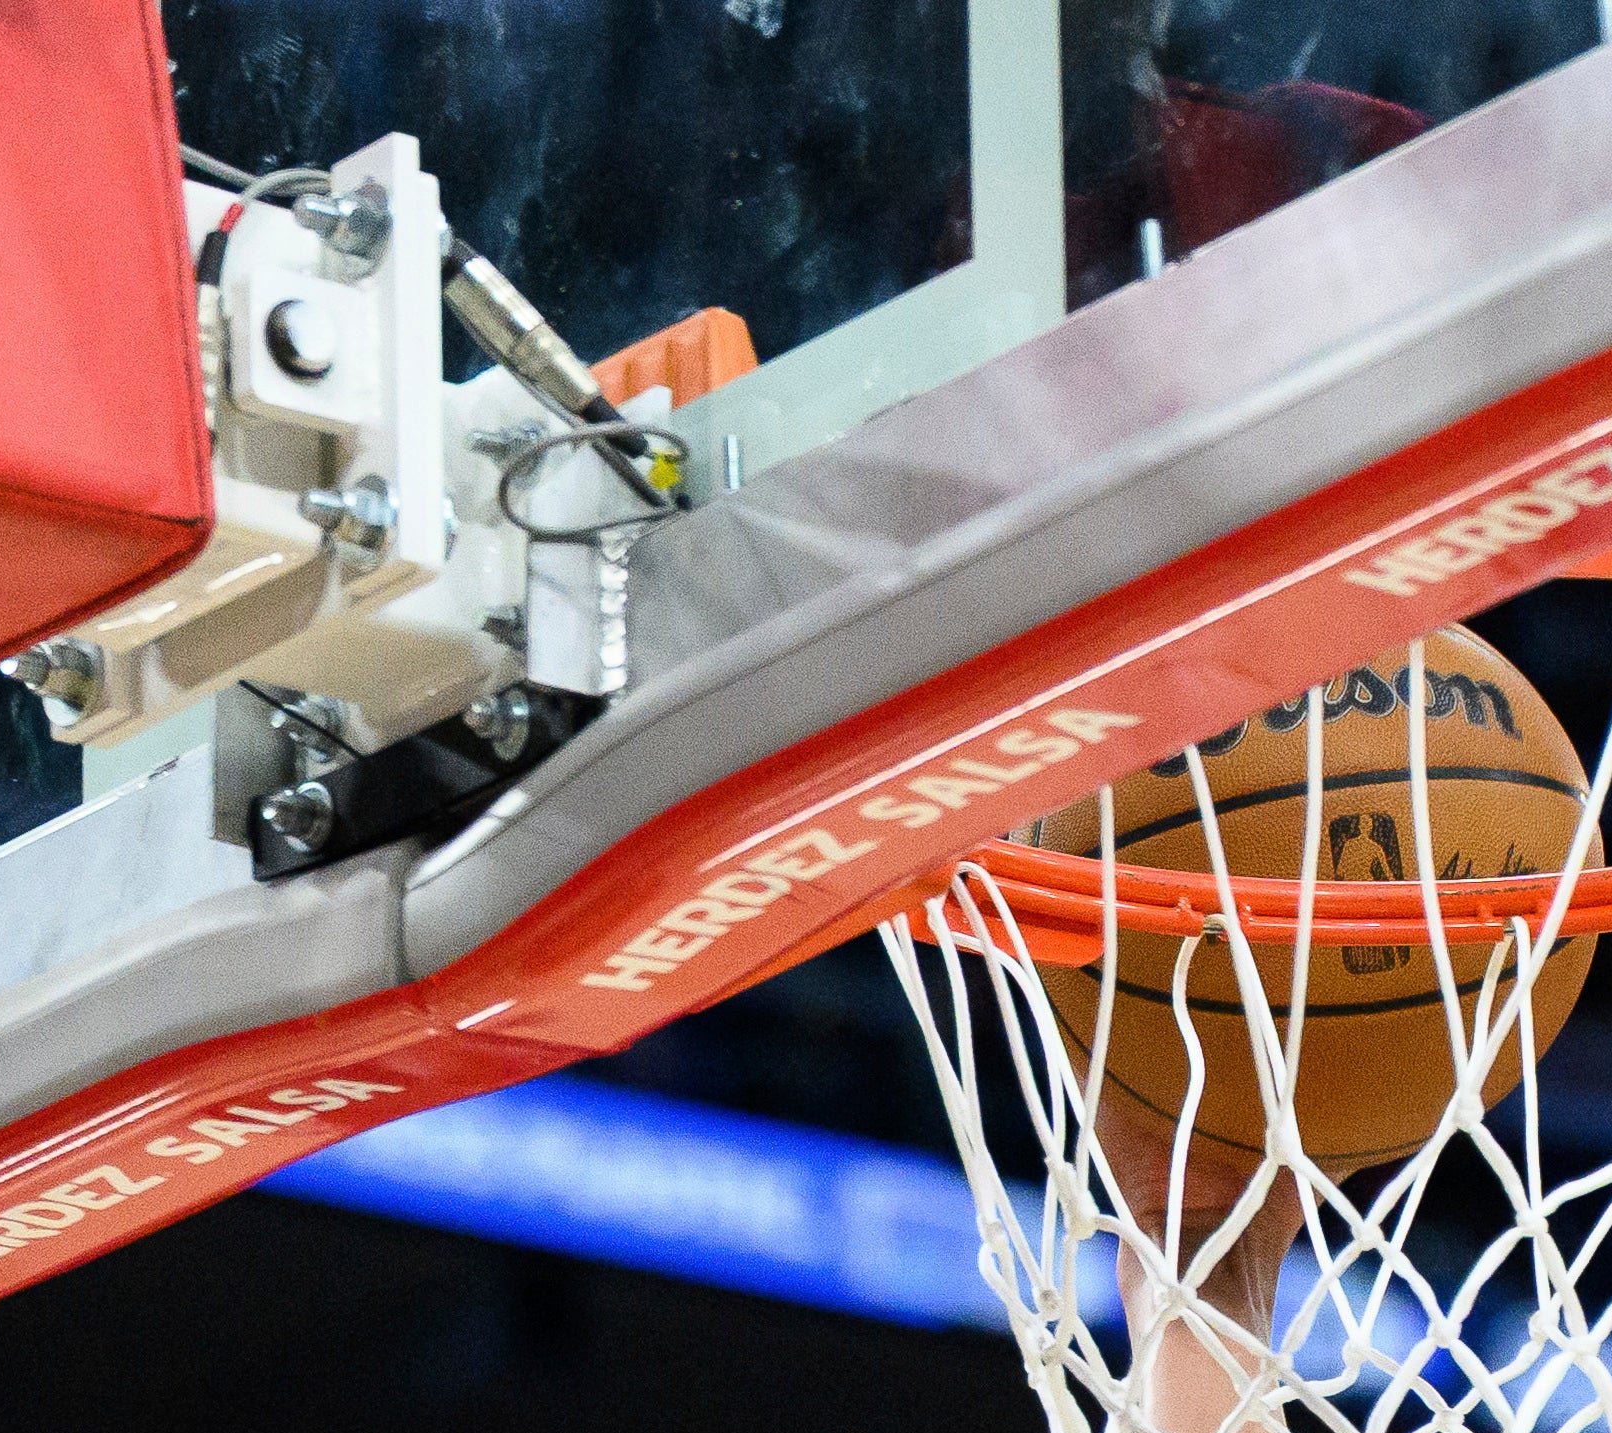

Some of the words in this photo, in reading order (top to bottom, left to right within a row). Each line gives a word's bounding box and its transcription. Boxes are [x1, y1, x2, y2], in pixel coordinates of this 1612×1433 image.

[580, 828, 878, 993] HERDEZ
[859, 708, 1142, 829] SALSA
[144, 1077, 406, 1165] SALSA
